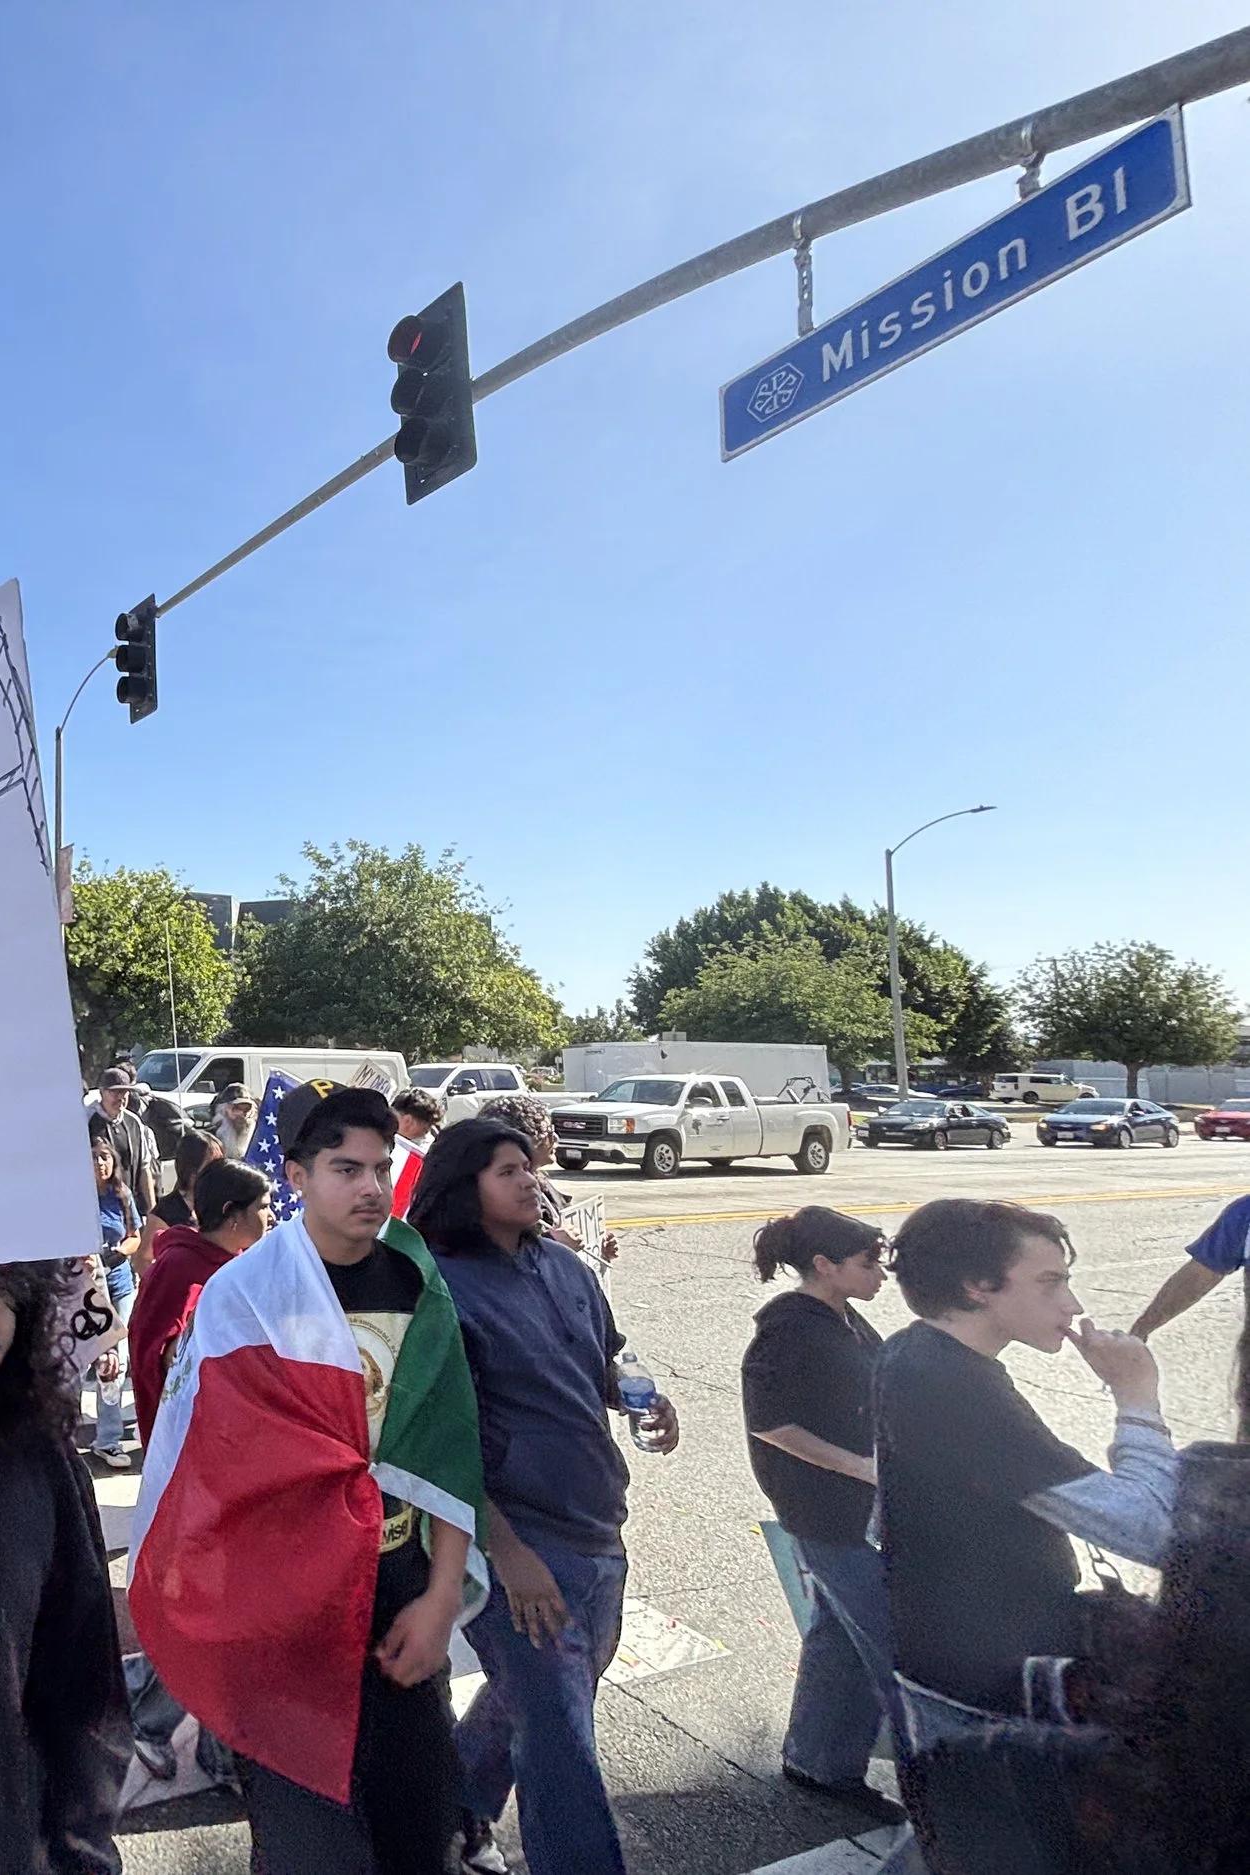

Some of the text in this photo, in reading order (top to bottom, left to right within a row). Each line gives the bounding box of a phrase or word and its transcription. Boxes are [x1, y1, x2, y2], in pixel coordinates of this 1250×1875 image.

[821, 167, 1127, 382] Mission Bl
[310, 1079, 334, 1099] P
[355, 1064, 376, 1087] MY
[564, 1201, 606, 1245] TIME
